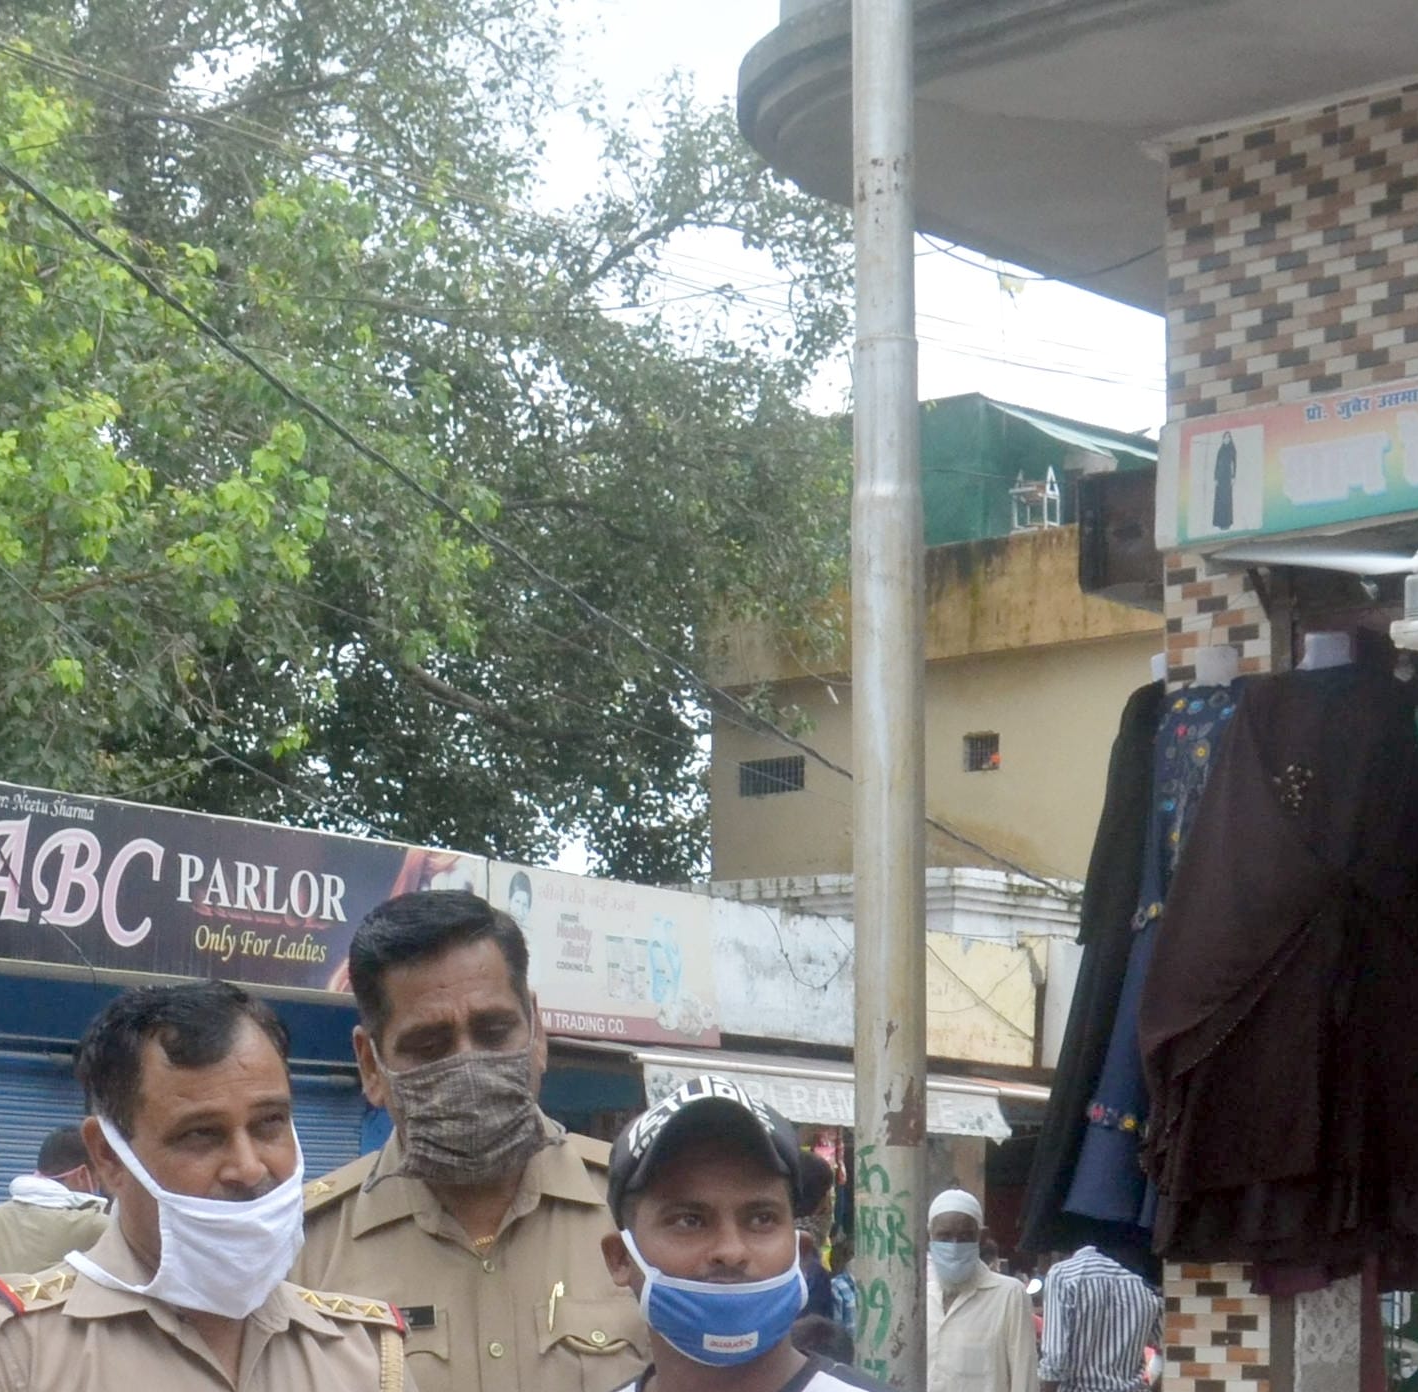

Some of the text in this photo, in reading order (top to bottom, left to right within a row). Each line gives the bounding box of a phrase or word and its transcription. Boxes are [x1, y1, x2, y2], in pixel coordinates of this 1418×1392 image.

[50, 797, 95, 821] Sharma
[176, 853, 349, 923] PARLOR
[195, 924, 327, 964] Only For Ladies
[554, 1012, 606, 1033] TRADING
[607, 1018, 627, 1034] CO.
